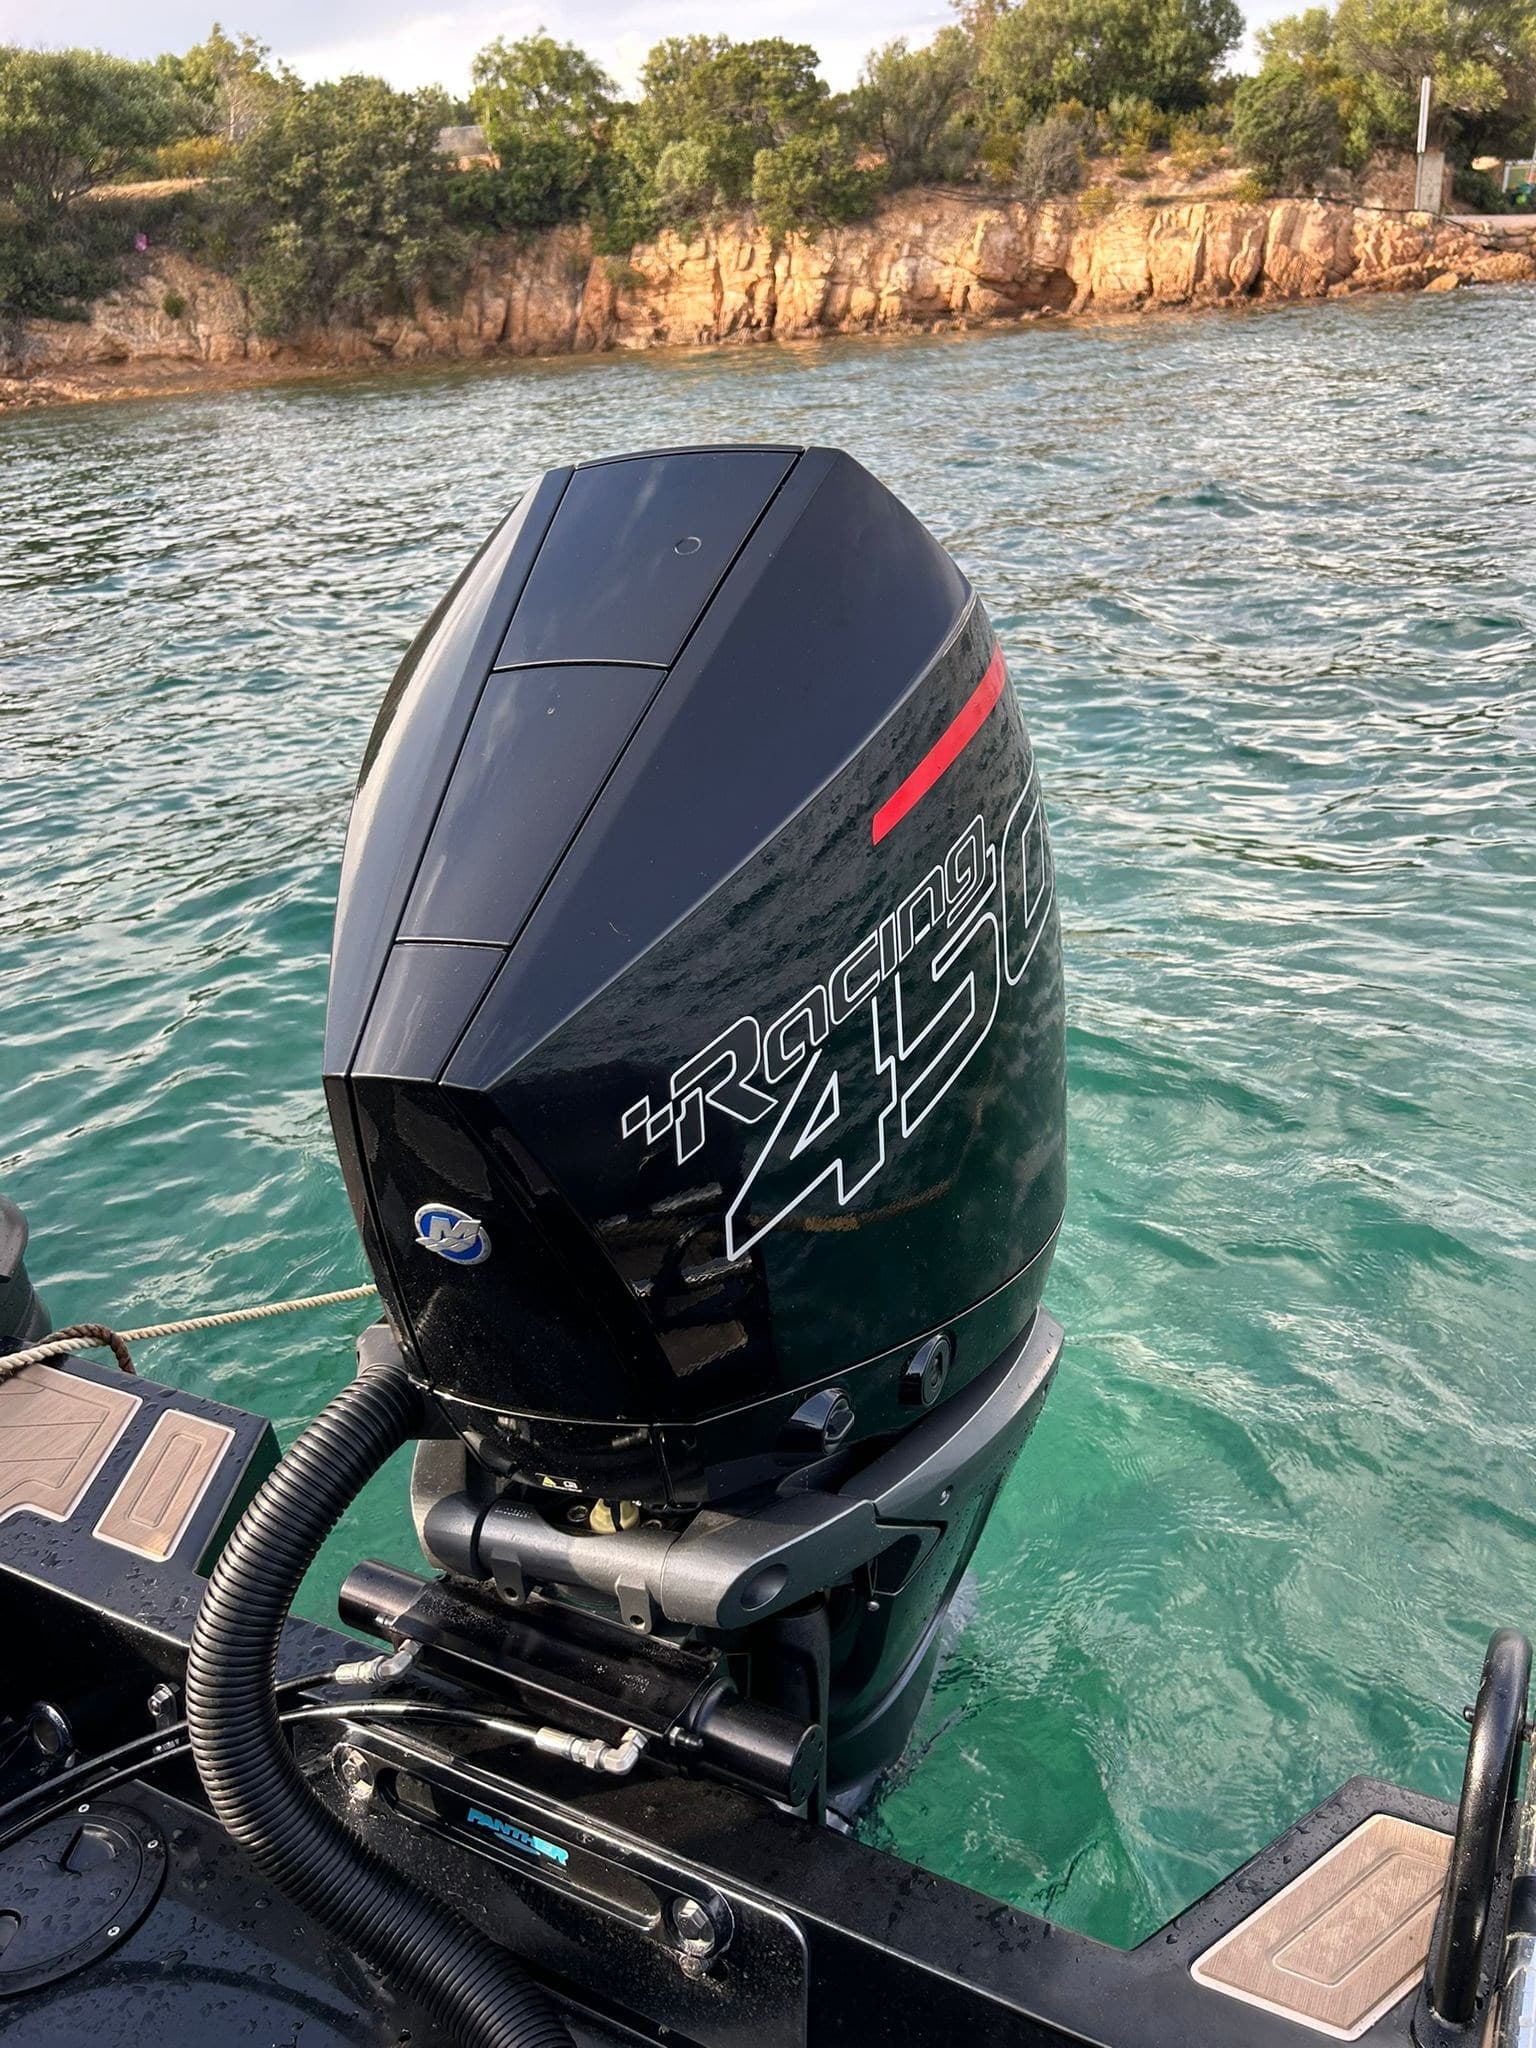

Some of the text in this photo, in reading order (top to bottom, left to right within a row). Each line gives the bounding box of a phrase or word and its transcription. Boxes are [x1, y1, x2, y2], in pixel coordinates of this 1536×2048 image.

[669, 814, 996, 1165] Racing
[725, 749, 1054, 1262] 450
[467, 1807, 569, 1866] PANTHER
